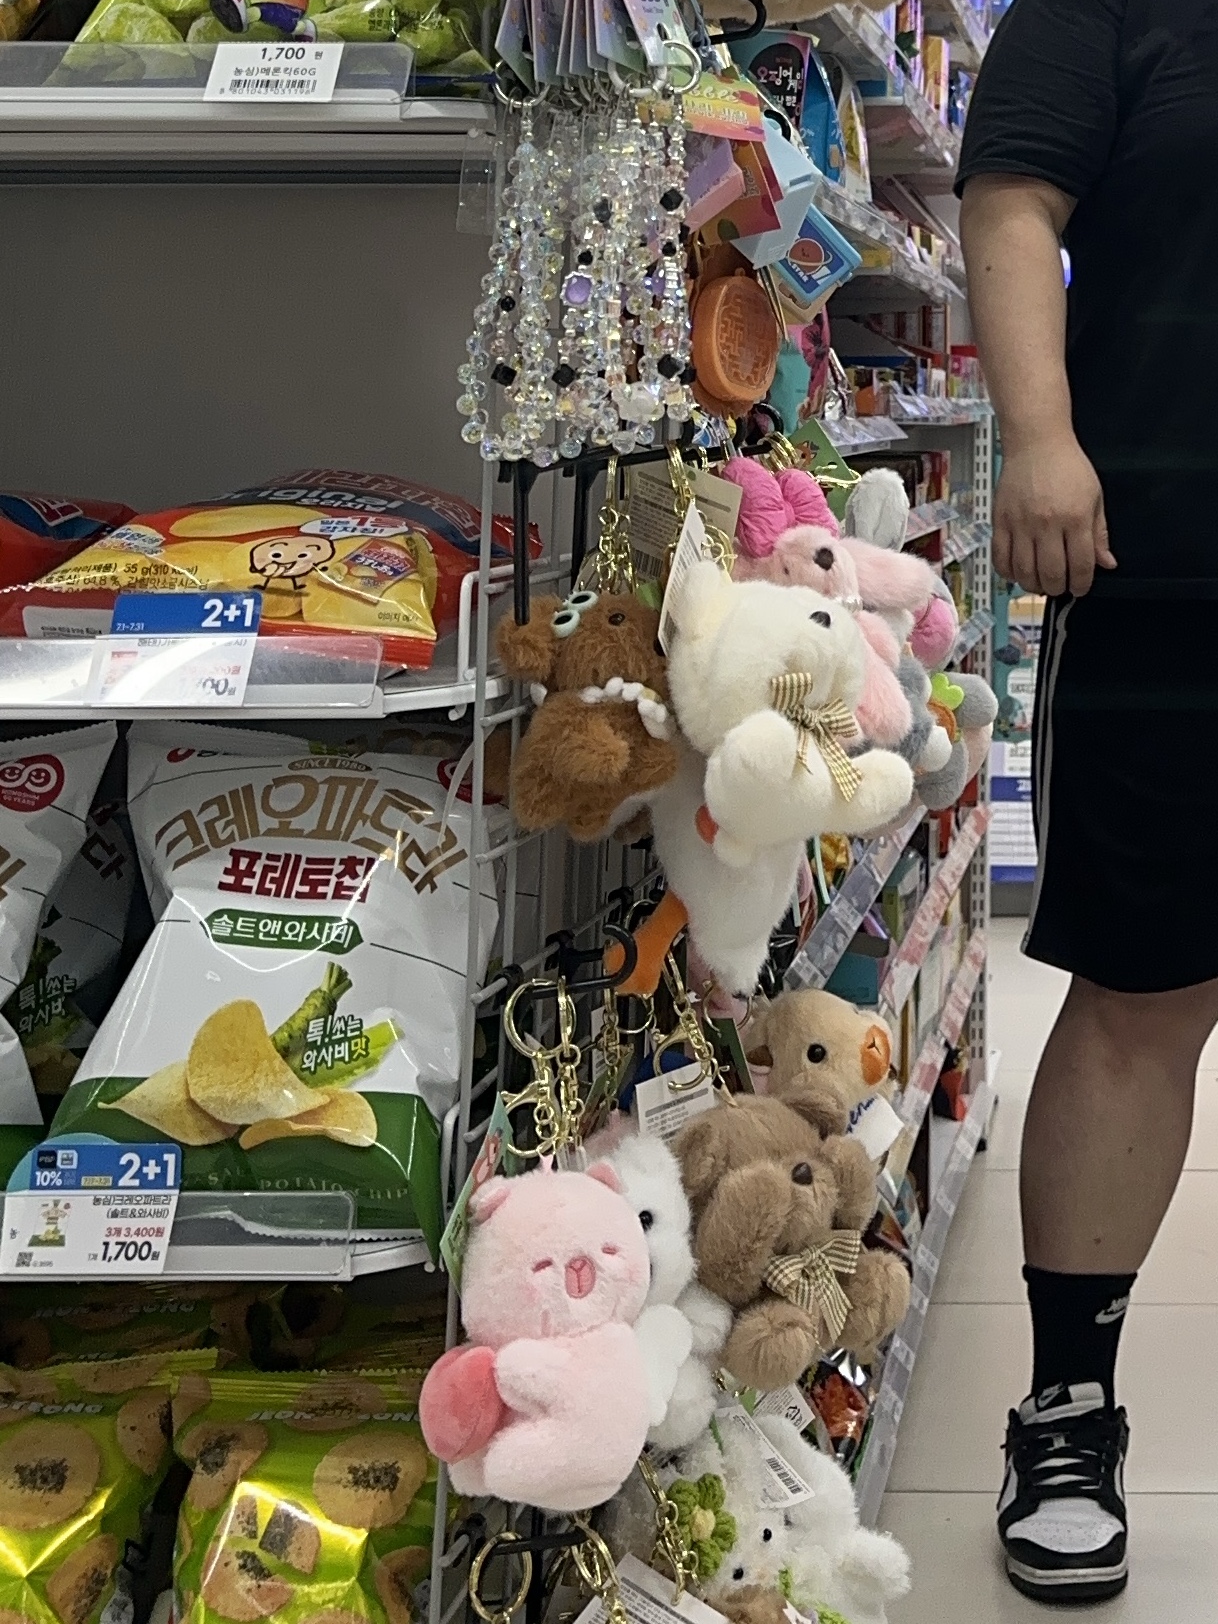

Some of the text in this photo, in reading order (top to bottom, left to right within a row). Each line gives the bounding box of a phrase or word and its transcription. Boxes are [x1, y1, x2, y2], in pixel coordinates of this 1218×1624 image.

[261, 47, 306, 62] 1,700
[123, 563, 138, 573] 55
[201, 598, 255, 627] 2+1
[293, 757, 367, 772] SINCE 1980
[155, 774, 469, 895] 크레오파트라
[217, 848, 378, 904] 포테토칩
[210, 913, 354, 949] 솔트앤와사비
[302, 1034, 370, 1071] 와사비맛
[118, 1152, 177, 1187] 2+1
[36, 1171, 62, 1186] 10%
[259, 1177, 343, 1192] POTATO
[92, 1194, 172, 1206] 농심)크레오파트라
[106, 1208, 170, 1219] (솔트&와사비)
[105, 1227, 165, 1238] 3개 3,400원
